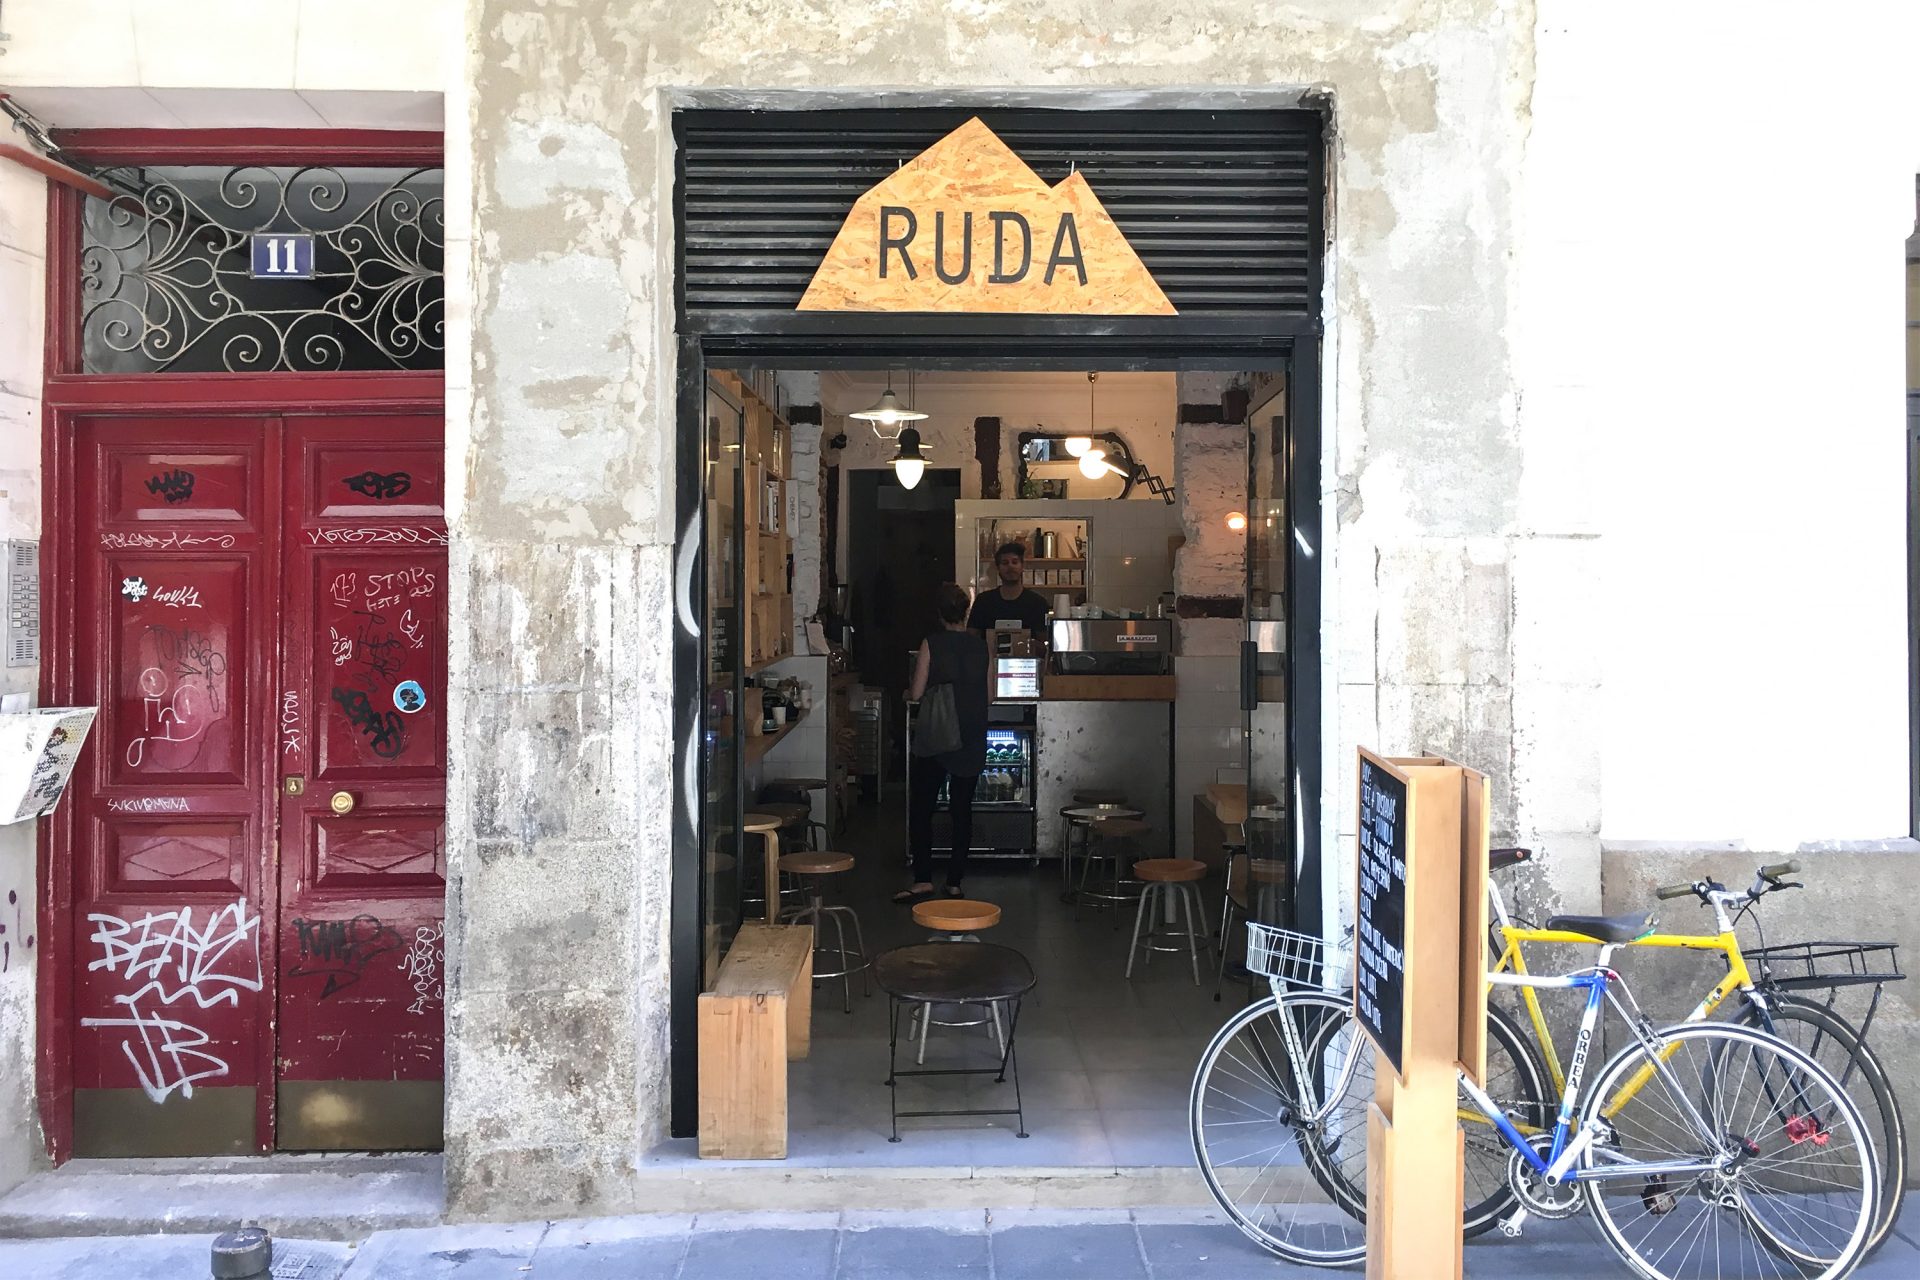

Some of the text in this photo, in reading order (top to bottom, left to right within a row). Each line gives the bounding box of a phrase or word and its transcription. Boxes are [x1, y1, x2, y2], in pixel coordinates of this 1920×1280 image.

[266, 239, 299, 274] 11
[879, 206, 1088, 287] RUDA
[1567, 1028, 1592, 1090] ORBEA
